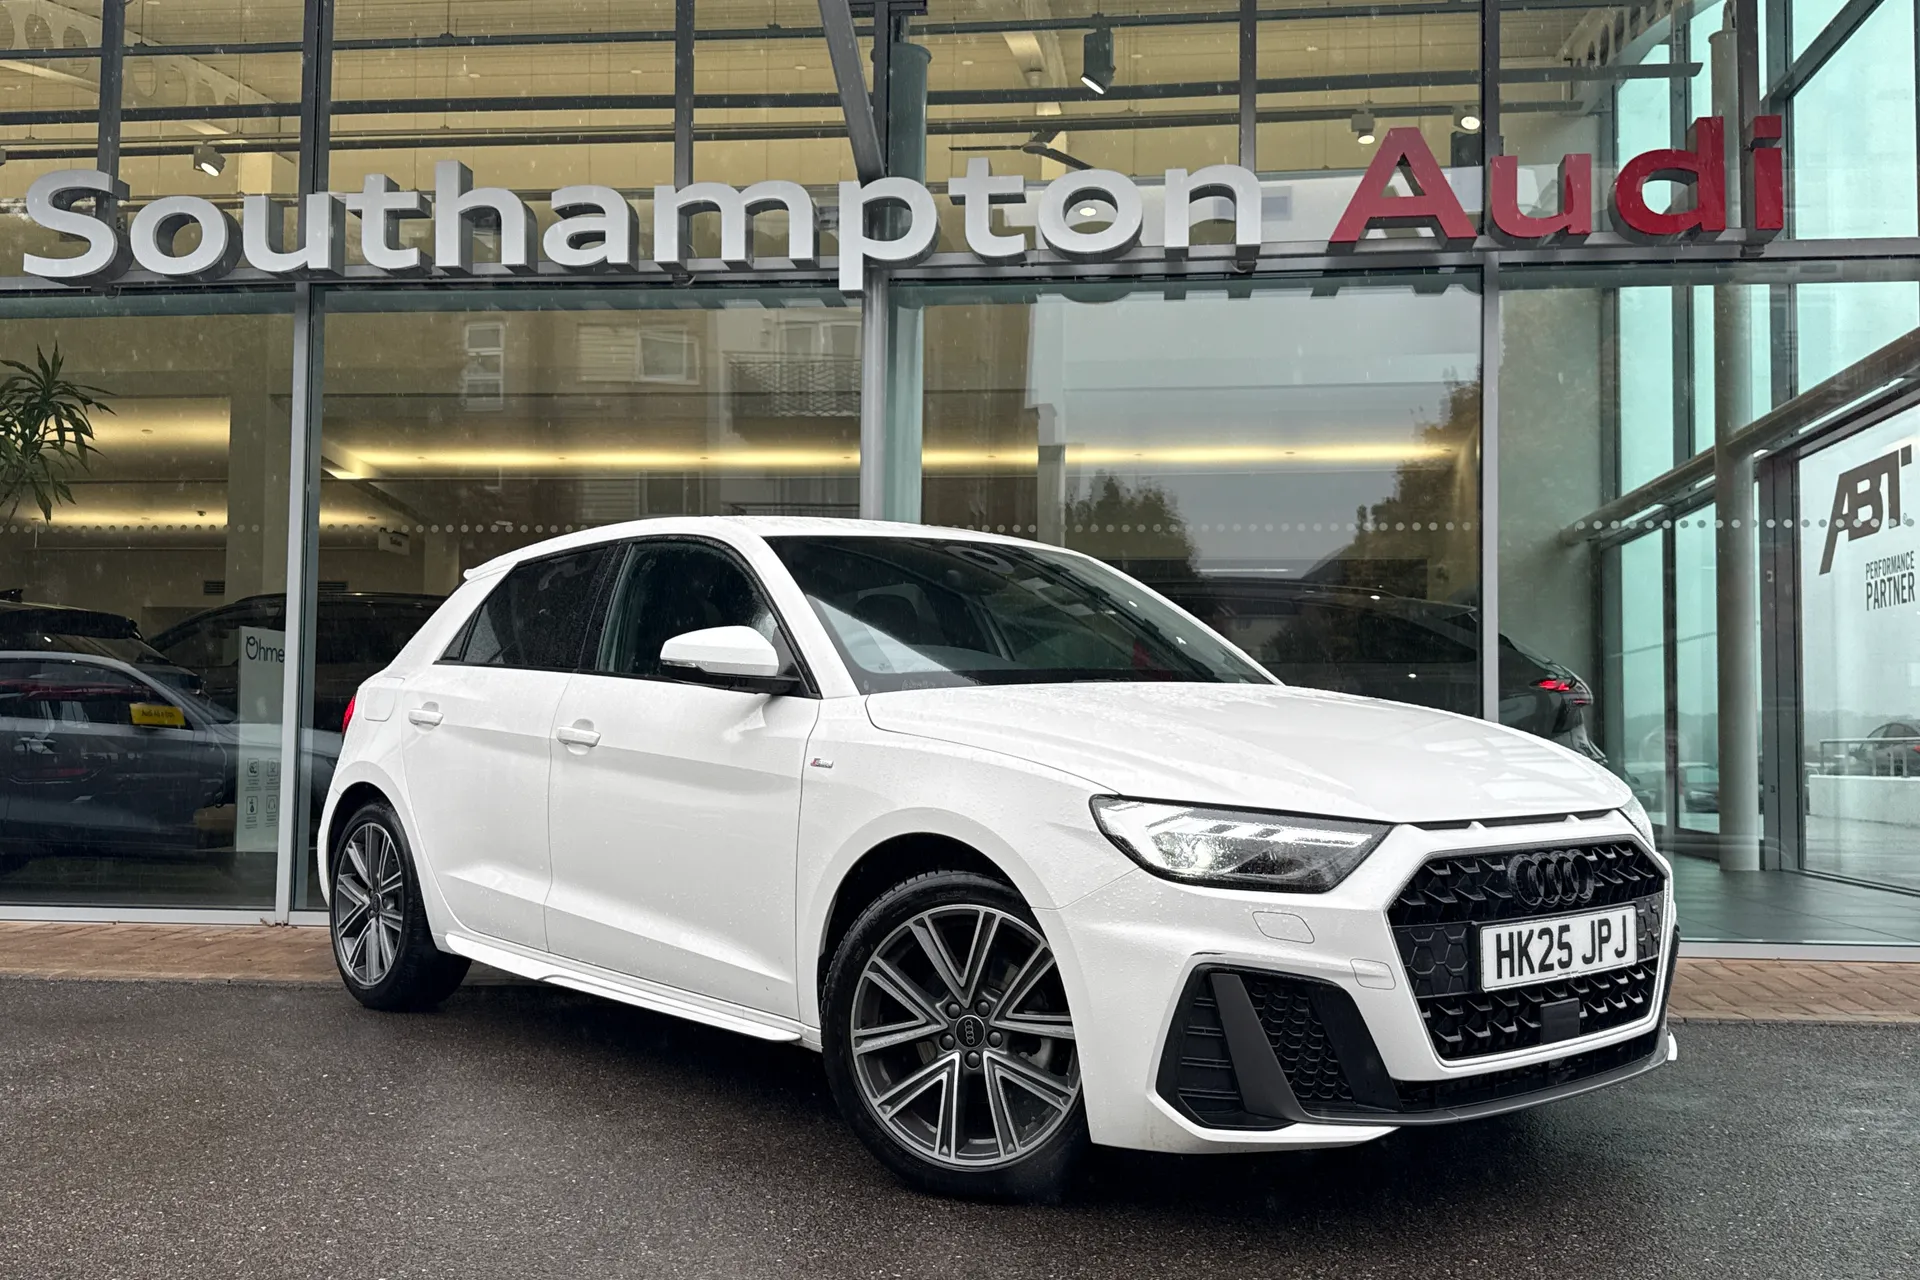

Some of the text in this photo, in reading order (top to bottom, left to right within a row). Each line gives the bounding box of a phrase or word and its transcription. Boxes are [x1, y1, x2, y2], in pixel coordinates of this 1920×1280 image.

[23, 115, 1784, 293] Southampton Audi
[1819, 444, 1912, 575] ABT
[1866, 551, 1915, 580] PERFORMANCE
[1866, 572, 1915, 612] PARTNER
[245, 635, 285, 663] Ohme
[1496, 914, 1627, 979] HK25 JPJ
